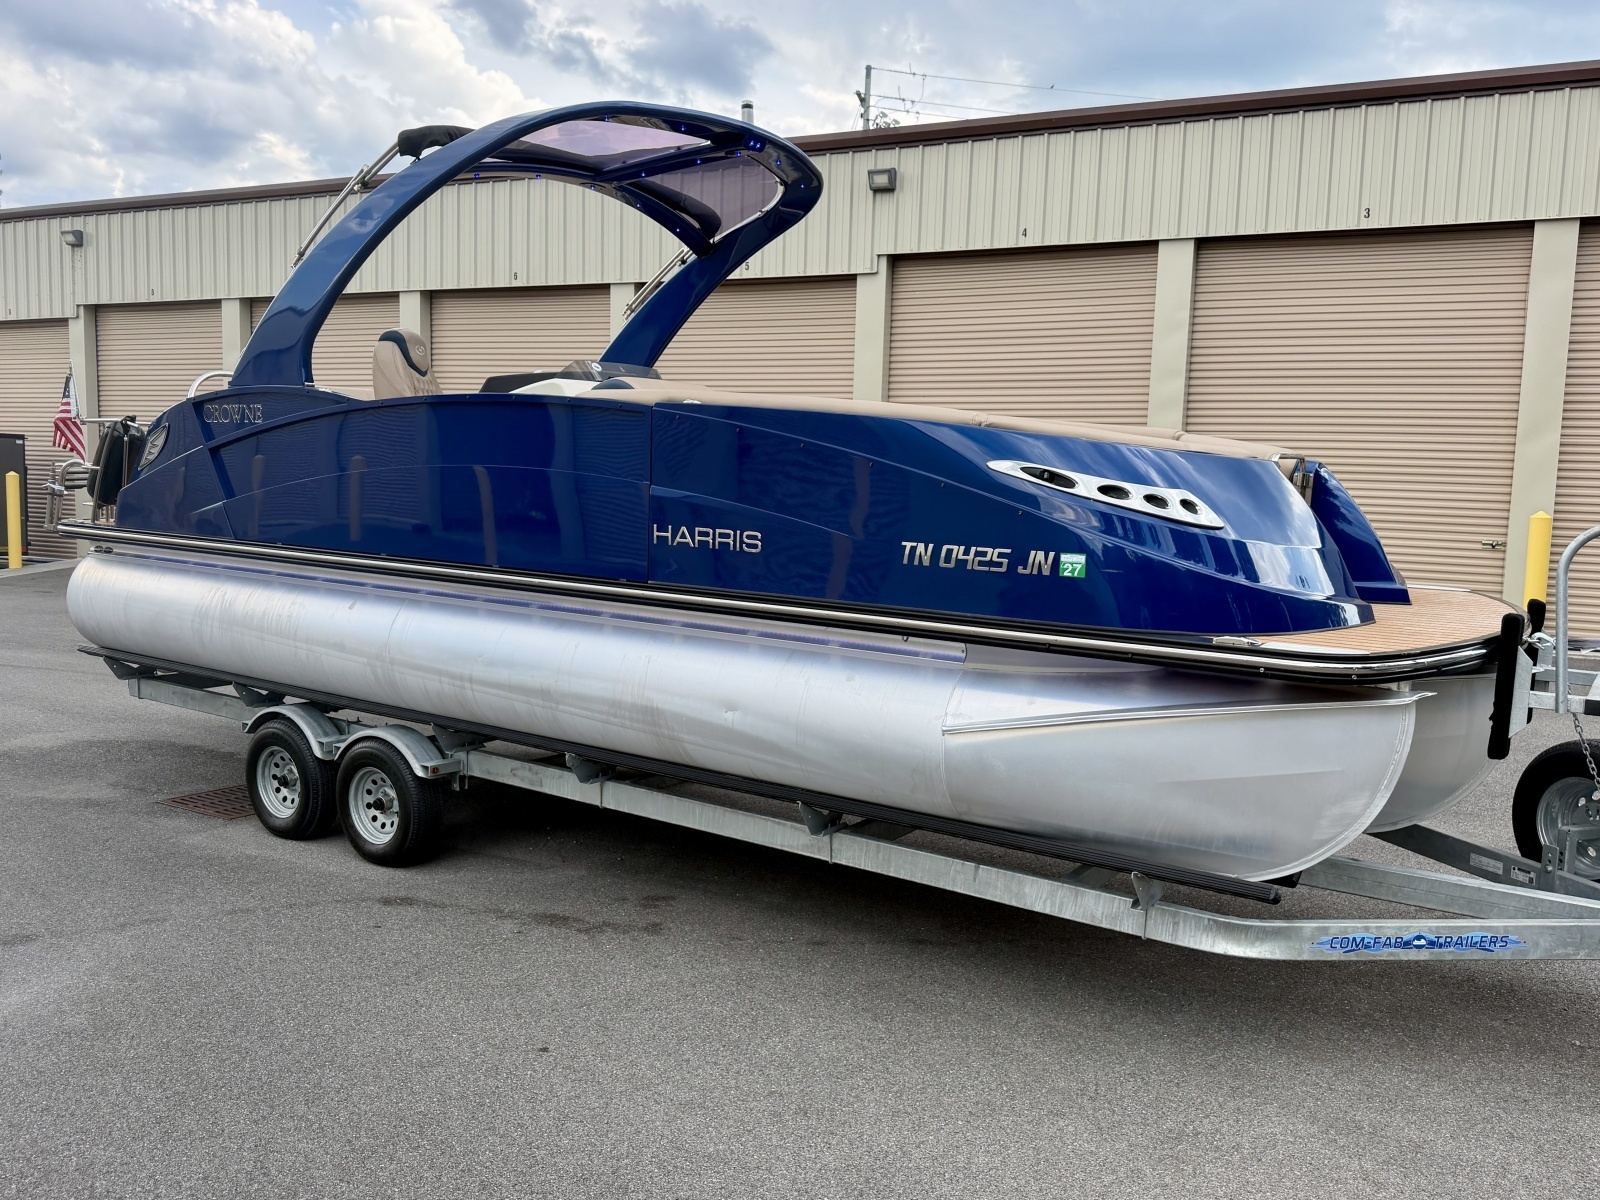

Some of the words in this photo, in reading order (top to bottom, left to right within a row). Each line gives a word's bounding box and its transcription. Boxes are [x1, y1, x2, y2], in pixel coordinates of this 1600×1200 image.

[1363, 207, 1371, 219] 3
[1021, 227, 1028, 238] 4
[744, 261, 750, 271] 5
[513, 272, 518, 281] 6
[203, 404, 264, 423] CROWNE
[653, 523, 762, 553] HARRIS
[901, 541, 935, 567] TN
[938, 544, 1012, 573] 0425
[1017, 550, 1056, 576] JN
[1063, 563, 1084, 577] 27
[1329, 936, 1404, 949] COM-FAB
[1434, 935, 1510, 949] TRAILERS
